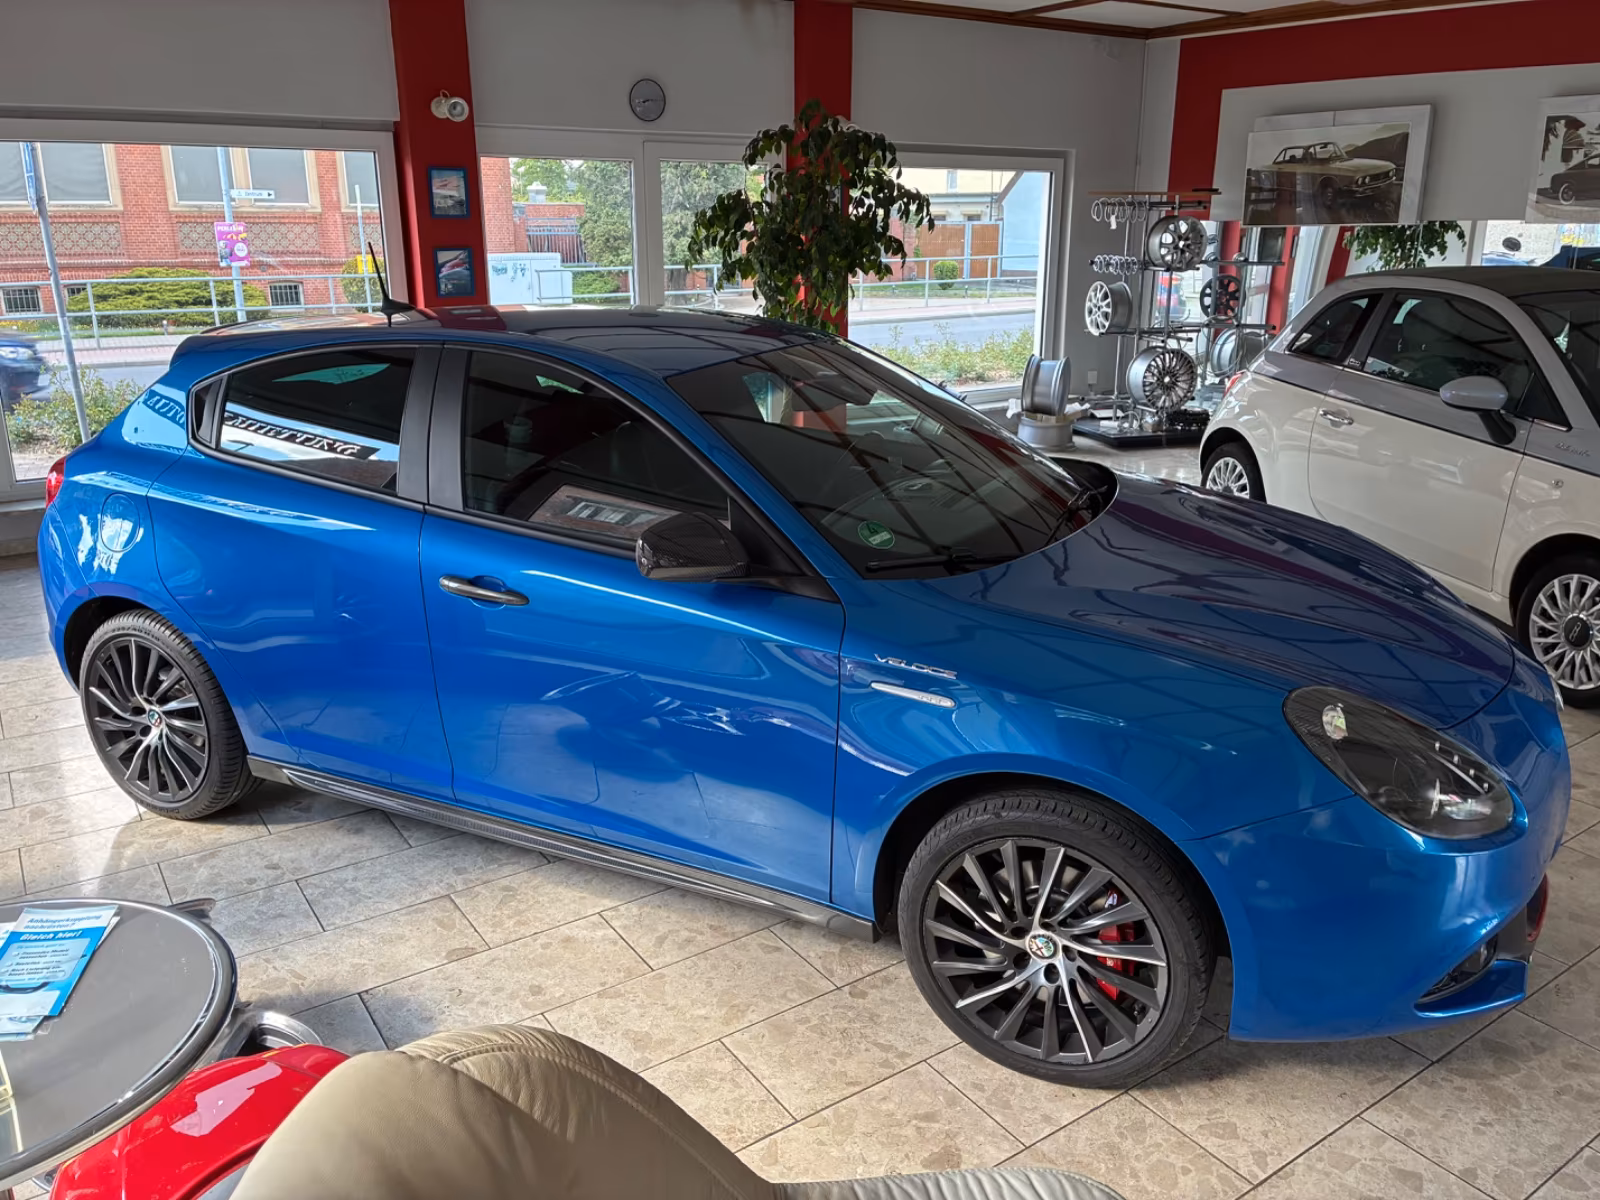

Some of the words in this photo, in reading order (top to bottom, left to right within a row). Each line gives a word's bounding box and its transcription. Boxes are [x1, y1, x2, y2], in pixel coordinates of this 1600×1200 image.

[874, 653, 958, 680] VELOCE
[19, 931, 54, 941] Gleich
[55, 930, 83, 939] hier!
